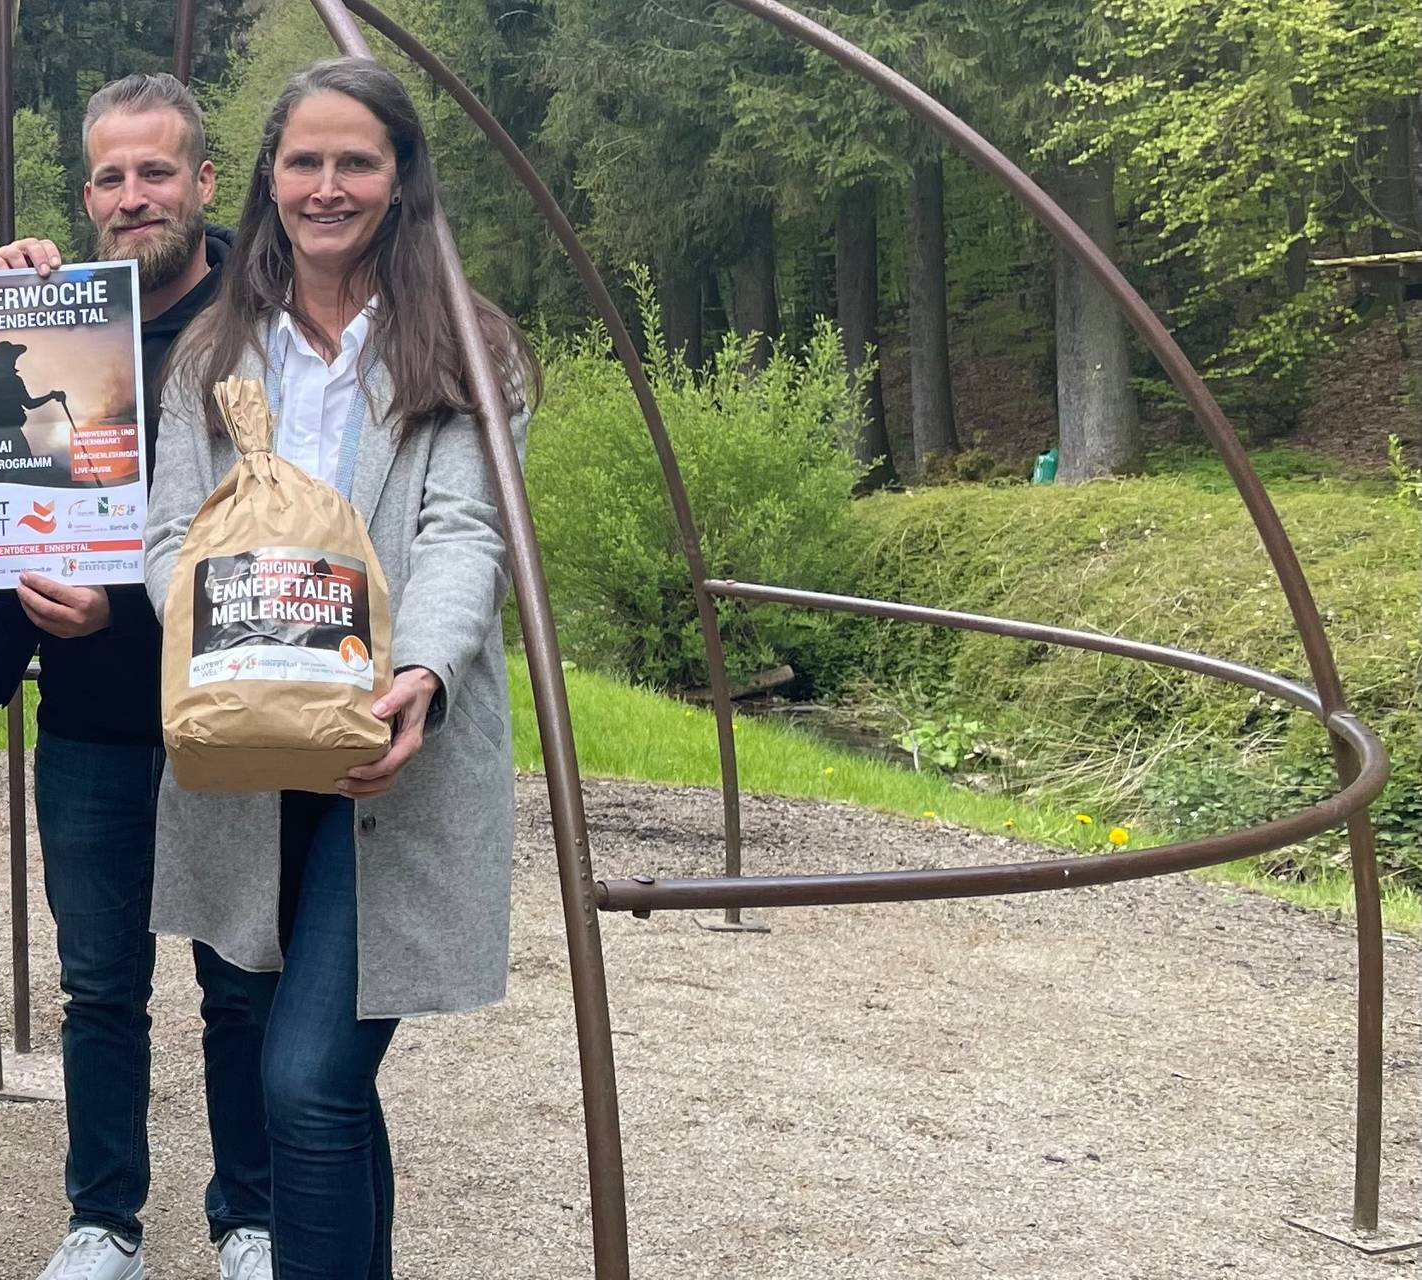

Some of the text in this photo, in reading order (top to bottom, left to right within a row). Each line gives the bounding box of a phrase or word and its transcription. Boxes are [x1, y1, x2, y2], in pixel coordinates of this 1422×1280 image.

[79, 308, 108, 324] TAL
[121, 428, 135, 436] UND
[250, 561, 314, 577] ORIGINAL
[211, 577, 354, 605] ENNEPETALER
[210, 601, 354, 628] MEILERKOHLE
[193, 661, 224, 672] KLUTERT
